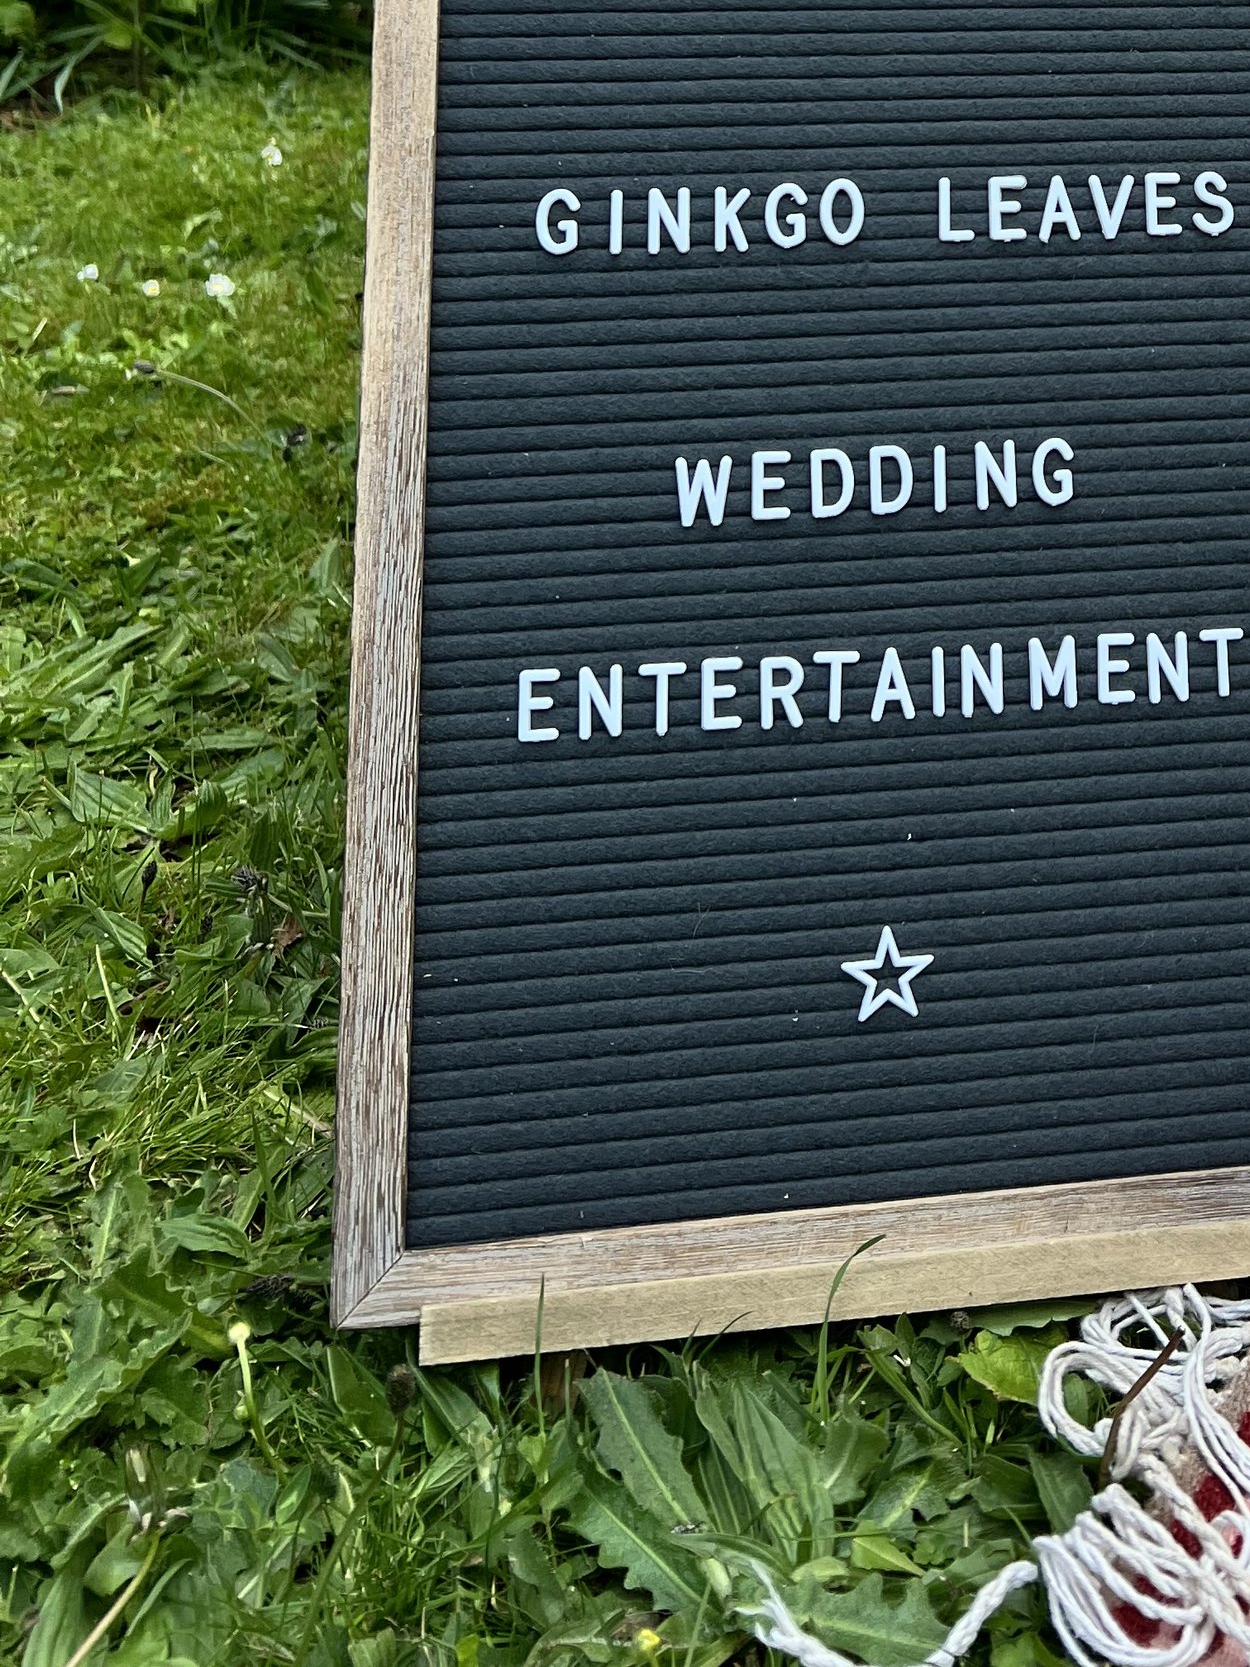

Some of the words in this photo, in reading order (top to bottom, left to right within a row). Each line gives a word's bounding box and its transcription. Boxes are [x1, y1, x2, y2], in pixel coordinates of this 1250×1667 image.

[535, 177, 866, 255] GINKGO
[938, 171, 1236, 243] LEAVES
[675, 437, 1074, 527] WEDDING
[518, 627, 1244, 742] ENTERTAINMENT
